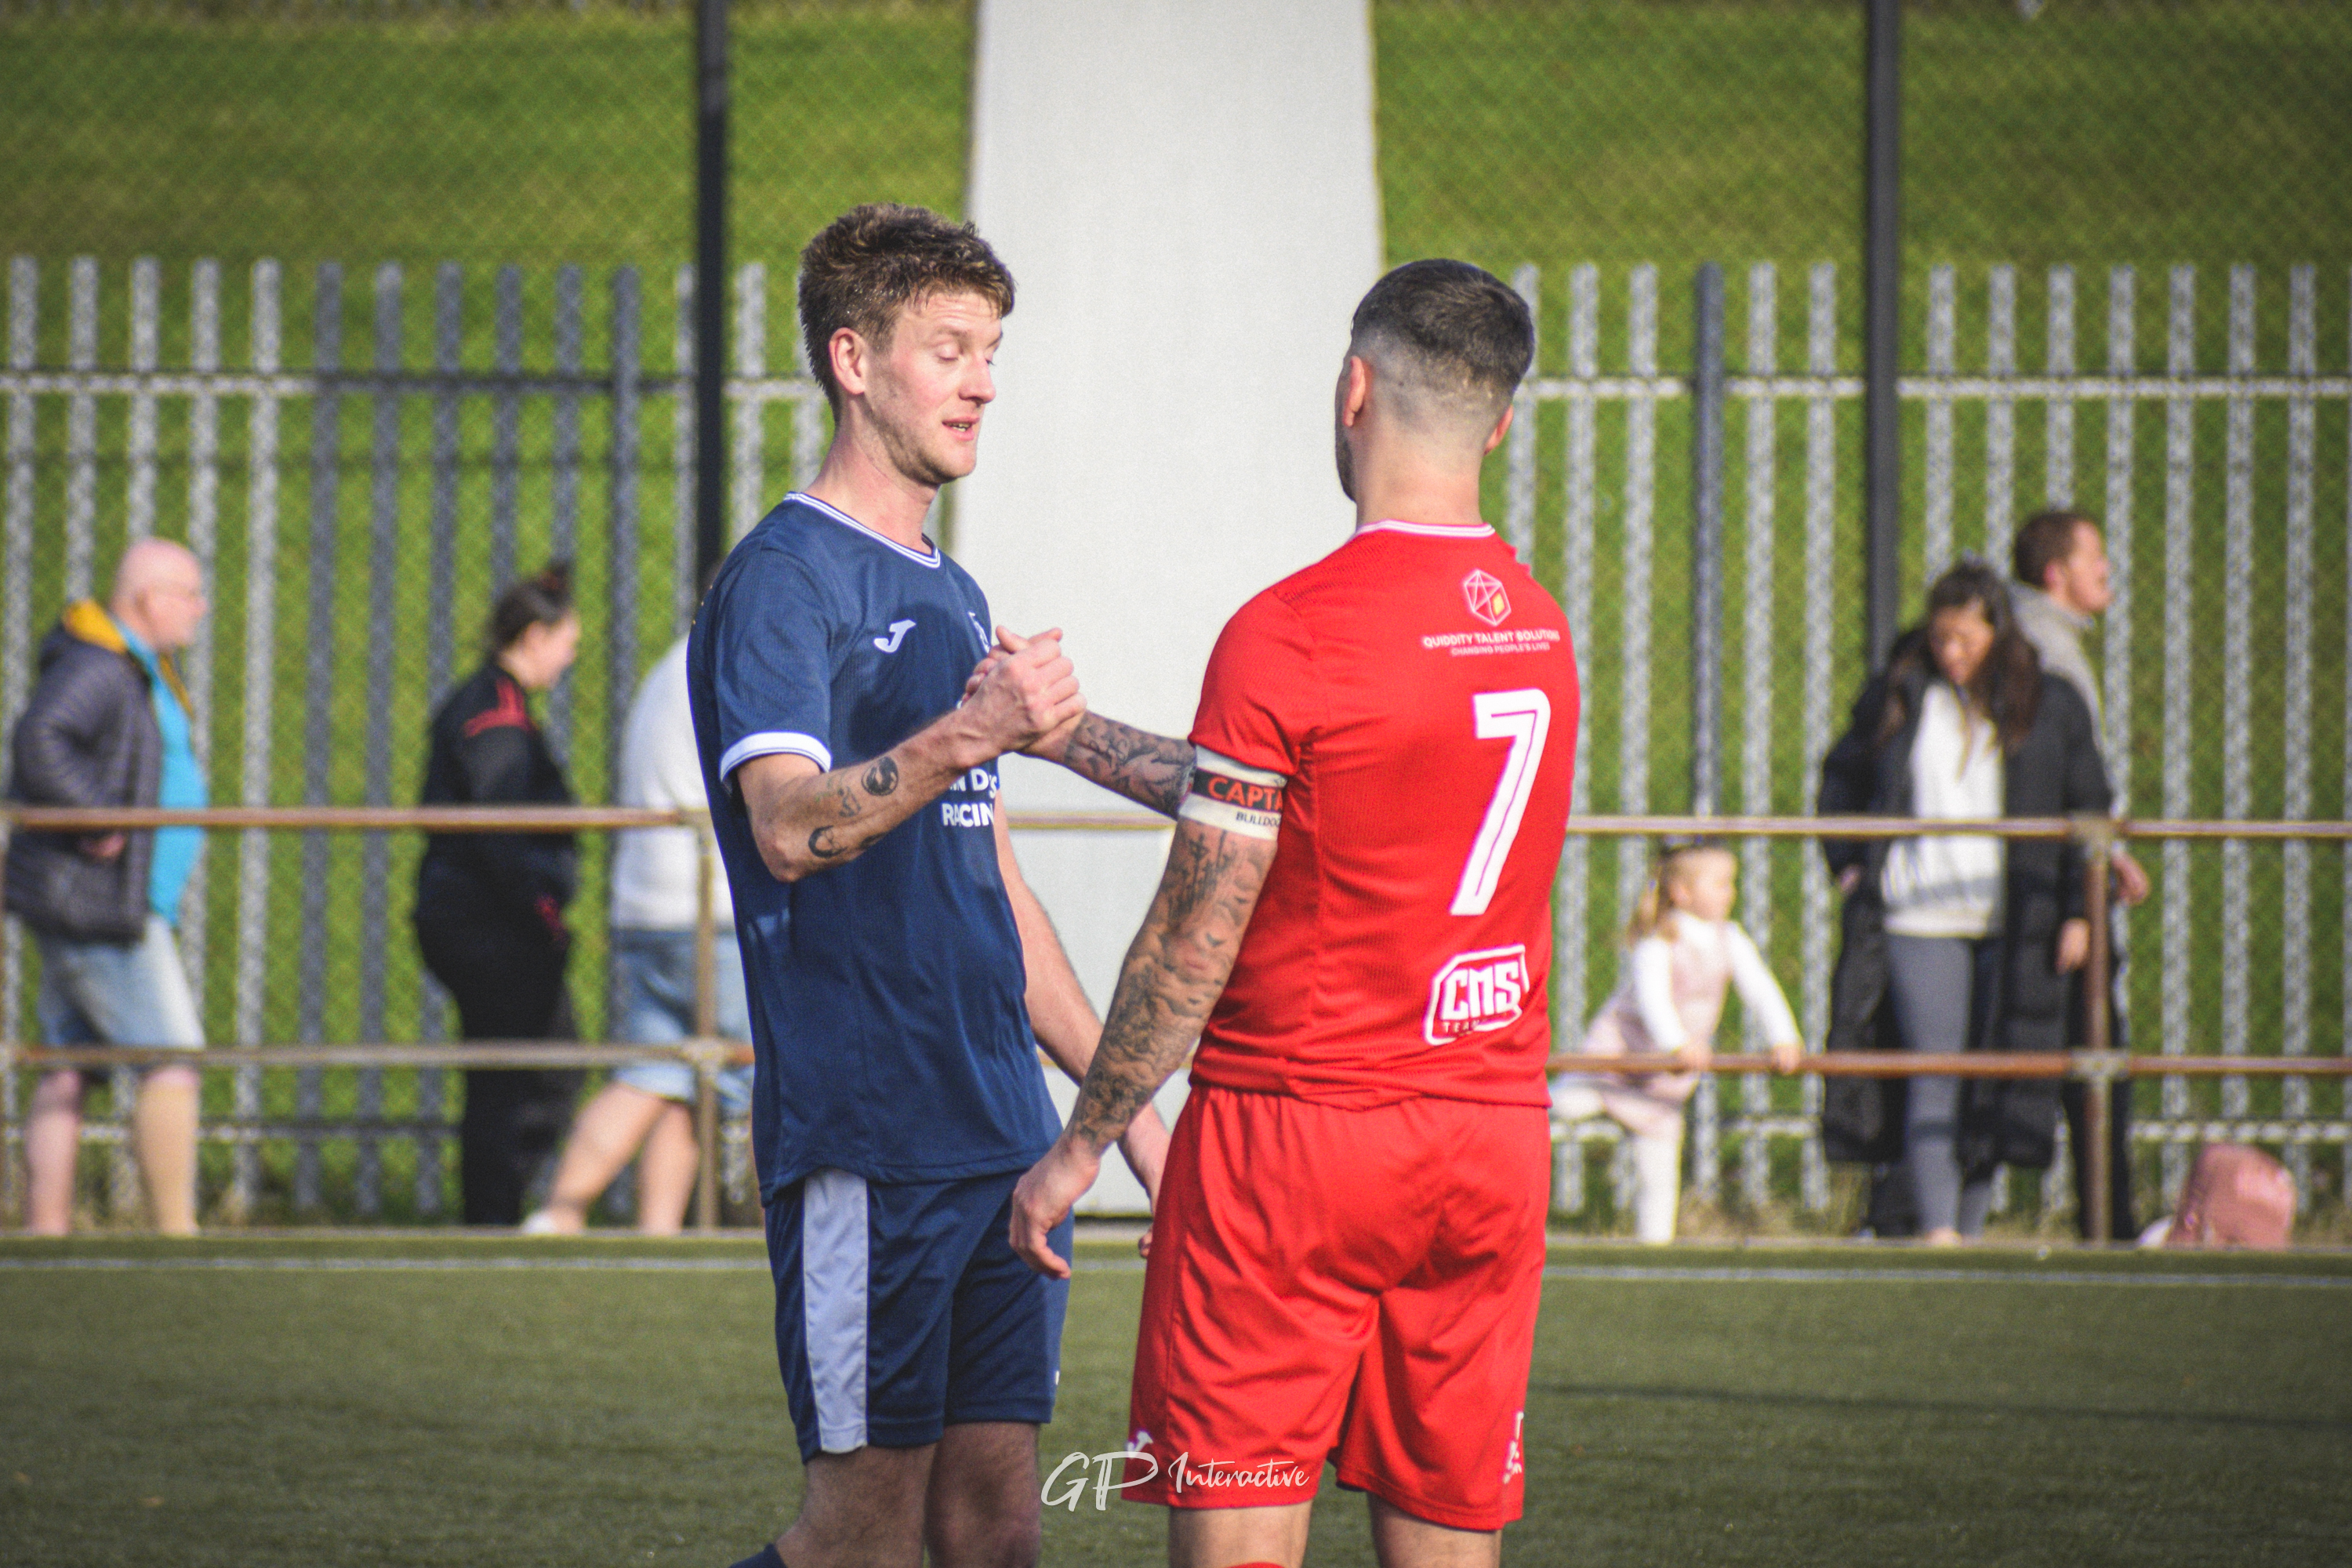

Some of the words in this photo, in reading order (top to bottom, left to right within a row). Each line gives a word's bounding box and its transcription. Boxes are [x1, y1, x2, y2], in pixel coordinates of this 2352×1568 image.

[1423, 633, 1473, 648] QUIDDITY
[1474, 631, 1514, 644] TALENT
[1451, 644, 1494, 656] CHANGING
[1450, 688, 1552, 916] 7
[1441, 960, 1521, 1020] CMS
